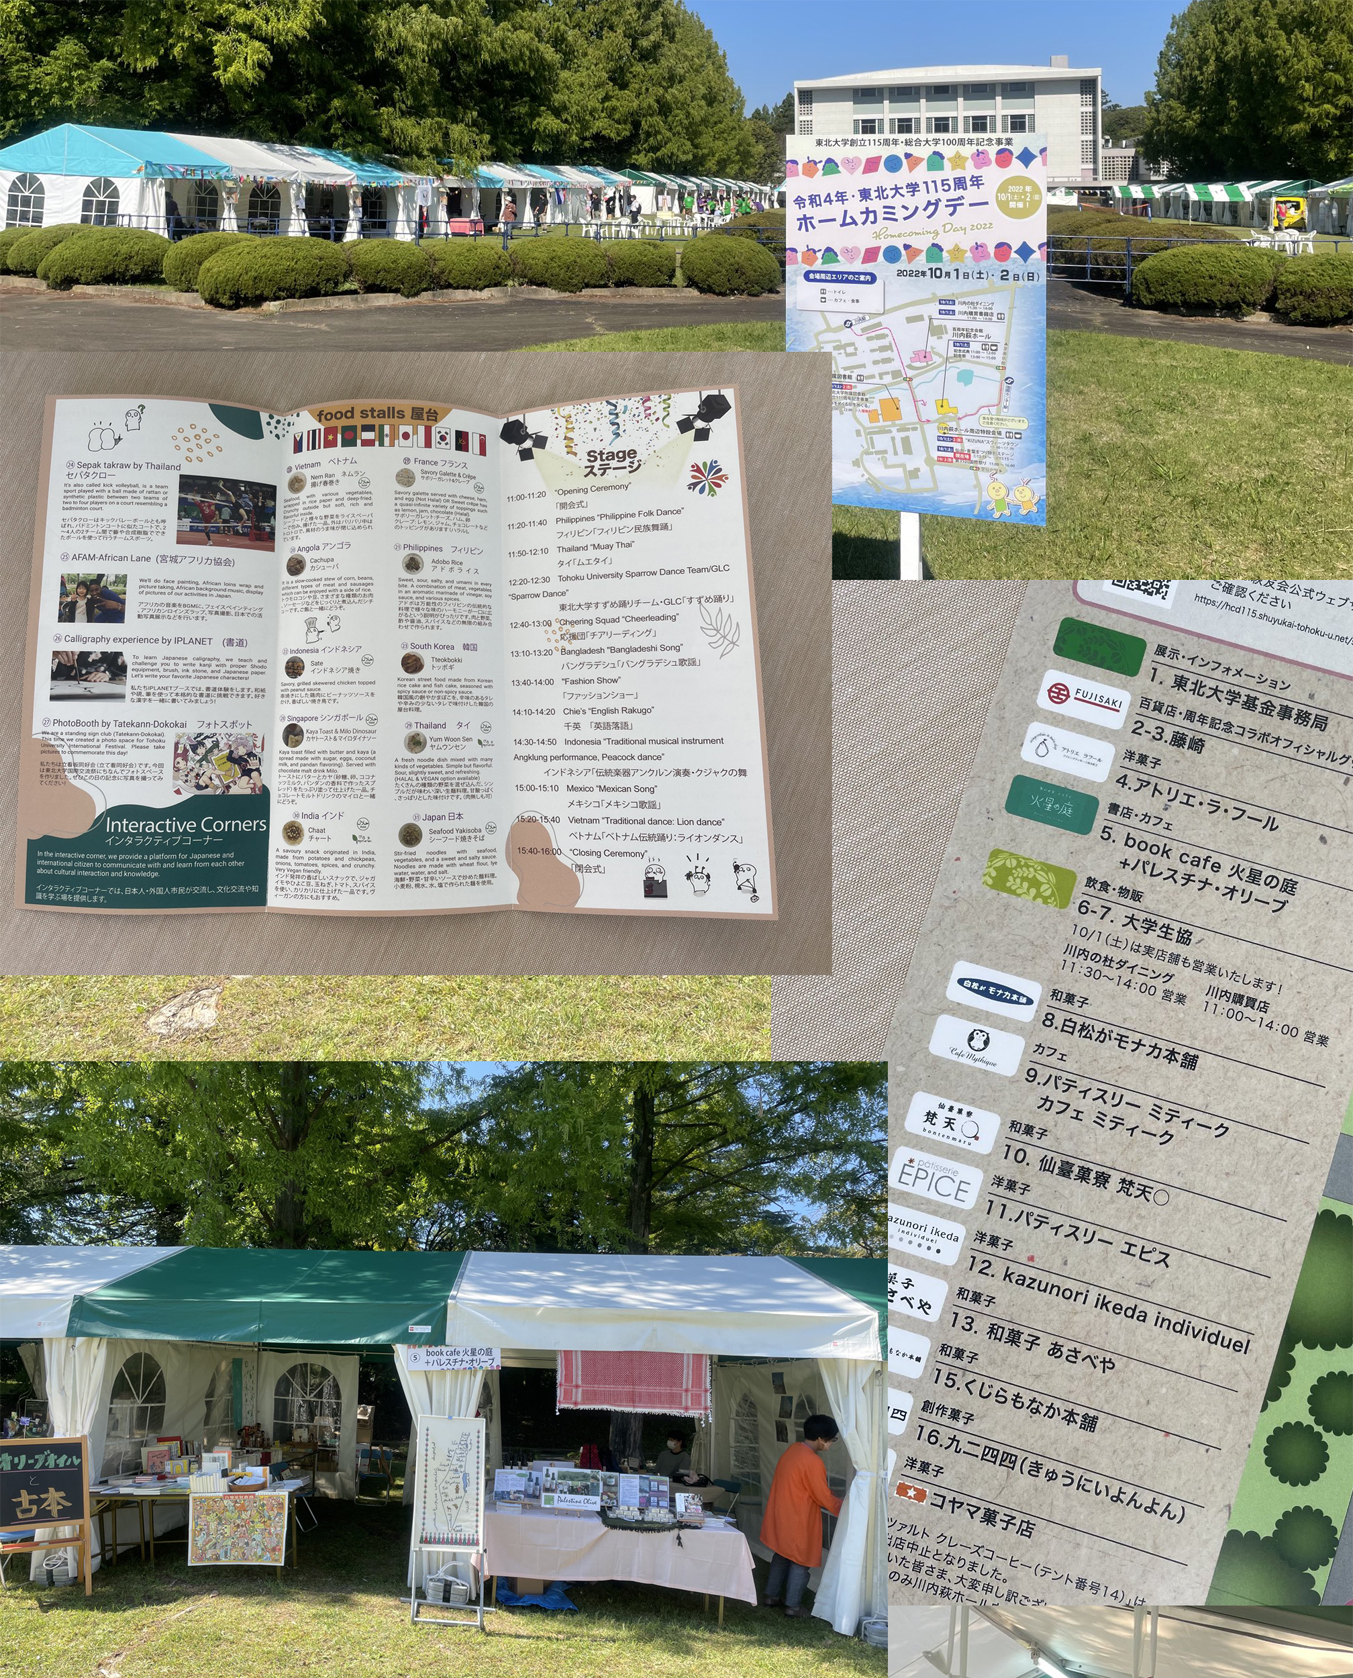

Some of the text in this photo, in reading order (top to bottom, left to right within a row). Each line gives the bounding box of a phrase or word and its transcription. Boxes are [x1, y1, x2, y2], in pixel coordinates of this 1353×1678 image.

[815, 137, 1014, 147] 東北大学創立115周年・総合大学100周年記念事業
[793, 174, 985, 210] 令和4年・東北大学115周年
[797, 197, 990, 233] ホームカミングデー
[872, 221, 994, 241] Homecoming Day 2022
[808, 272, 872, 282] 会場周辺エリアのご案内
[317, 406, 439, 423] food stalls 屋台
[294, 457, 358, 471] Vietnam ベトナム
[586, 449, 638, 463] Stage
[76, 461, 181, 473] Sepak takraw by Thailand
[583, 461, 642, 478] ステージ
[507, 491, 547, 503] 11:00-11:20
[554, 501, 588, 510] 「開会式」
[507, 519, 548, 530] 11:20-11:40
[555, 514, 595, 525] Philippines
[637, 510, 654, 519] Folk
[71, 553, 128, 564] AFAM-African
[130, 554, 152, 563] Lane
[403, 543, 484, 555] Philippines フィリピン
[509, 564, 731, 587] 12:20-12:30 Tohoku University Sparrow Dance Team/GLC
[1210, 580, 1293, 610] ご確認ください
[64, 634, 248, 648] Calligraphy experience by IPLANET (書道)
[1154, 643, 1292, 692] 展示・インフォメーション
[1075, 687, 1123, 710] FUJISAKI
[1150, 667, 1330, 732] 1. 東北大学基金事務局
[512, 708, 556, 717] 14:10-14:20
[52, 718, 253, 730] PhotoBooth by Tatekann-Dokokai フォトスポット
[564, 721, 581, 731] 千英
[422, 811, 464, 822] Japan 日本
[1030, 795, 1074, 818] 火星の庭
[1107, 802, 1174, 832] 書店・カフェ
[106, 816, 267, 834] Interactive Corners
[105, 835, 223, 847] インタラクティブコーナー
[1100, 826, 1300, 896] 5. book cafe 火星の庭
[1084, 875, 1145, 905] 飲食・物販
[1077, 900, 1193, 947] 6-7. 大学生協
[1063, 943, 1176, 984] 川内の杜ダイニング
[1050, 987, 1090, 1010] 和菓子
[1205, 984, 1271, 1014] 川内購買店
[1041, 1012, 1200, 1071] 8.白松がモナカ本舗
[1024, 1067, 1232, 1140] 9.パティスリー ミティーク
[1036, 1095, 1176, 1147] カフェ ミティーク
[922, 1127, 972, 1147] bontenmaru
[1002, 1144, 1031, 1168] 10.
[1038, 1155, 1112, 1190] 仙臺菓寮
[930, 1226, 960, 1244] ikeda
[1120, 1240, 1172, 1269] エピス
[967, 1256, 1252, 1357] 12. kazunori ikeda individuel
[425, 1349, 445, 1357] book
[445, 1349, 461, 1357] cafe
[462, 1347, 493, 1357] 火星の庭
[950, 1312, 1117, 1374] 13. 和菓子 あさべや
[920, 1399, 976, 1426] 創作菓子
[29, 1475, 40, 1486] と
[11, 1487, 73, 1520] 古本
[557, 1495, 597, 1506] Palestine Olive
[929, 1491, 1037, 1540] コヤマ菓子店
